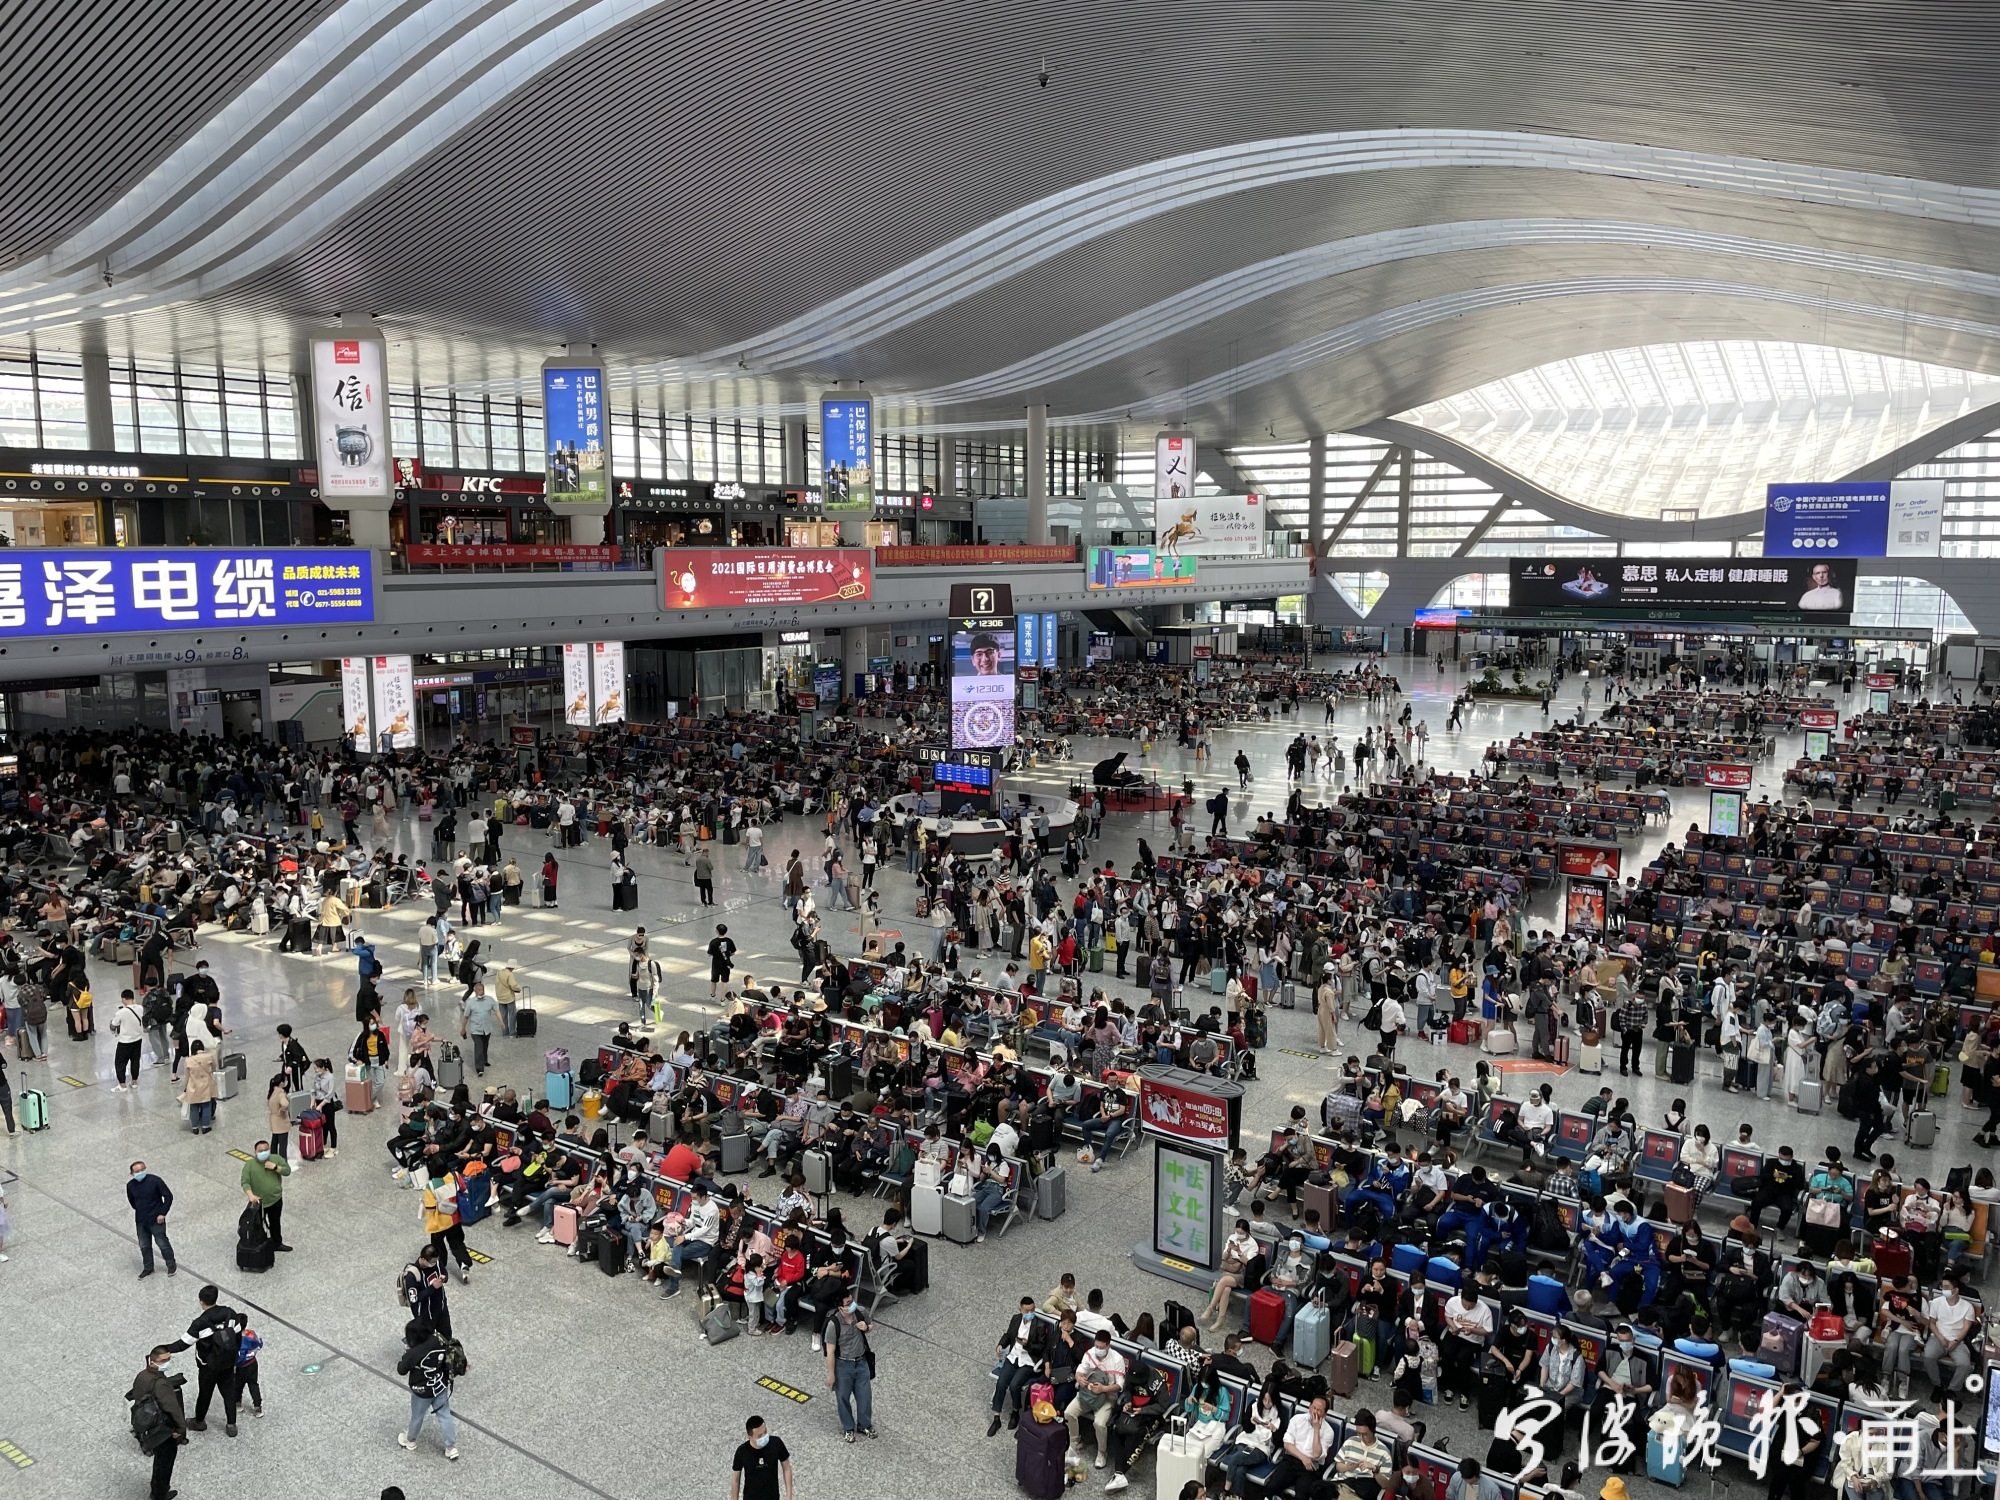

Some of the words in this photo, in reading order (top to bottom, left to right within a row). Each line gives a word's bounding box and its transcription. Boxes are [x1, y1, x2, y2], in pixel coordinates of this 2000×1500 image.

[333, 375, 363, 411] 信
[1166, 456, 1187, 475] 义
[461, 476, 504, 492] KFC
[423, 548, 516, 556] 天上不会掉馅饼
[283, 565, 361, 580] 品质成就未来
[1622, 565, 1658, 582] 慕思
[1665, 568, 1724, 583] 私人定制
[1728, 568, 1788, 583] 健康睡眠
[843, 583, 861, 596] 2021
[979, 620, 1004, 628] 12306
[781, 631, 809, 642] VERAGE
[975, 685, 1005, 694] 12306
